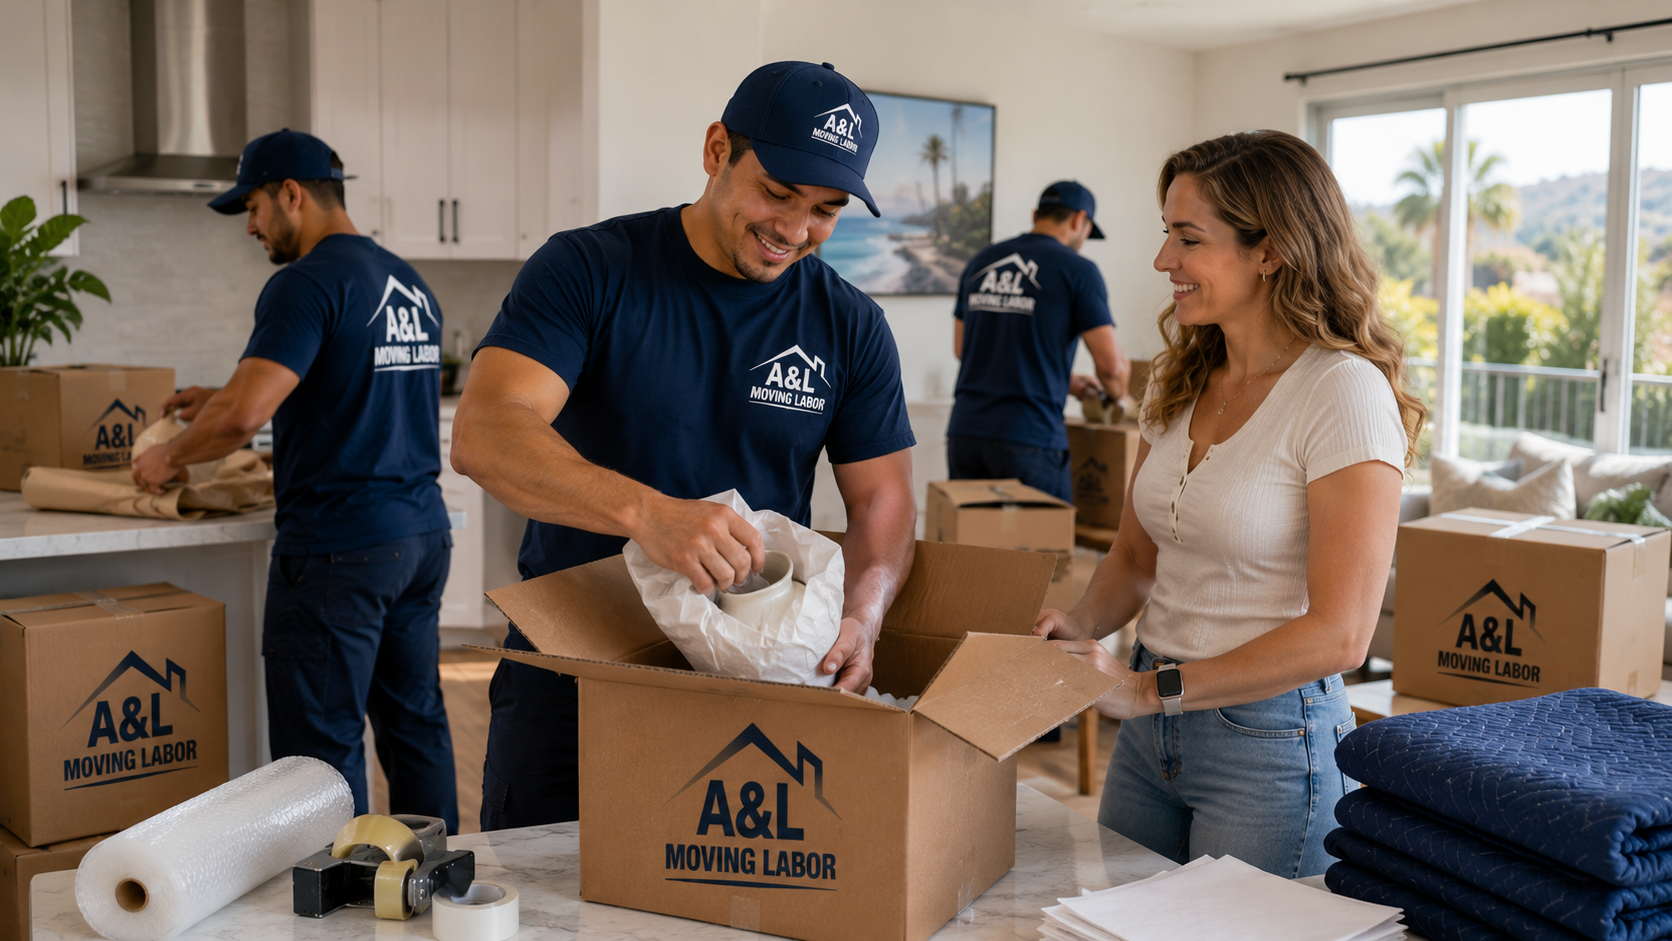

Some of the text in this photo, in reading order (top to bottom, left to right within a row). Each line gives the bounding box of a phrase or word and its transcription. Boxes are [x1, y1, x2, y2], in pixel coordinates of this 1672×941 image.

[812, 127, 839, 144] MOVING
[823, 114, 854, 140] A&L
[979, 269, 1024, 295] A&L
[386, 305, 429, 342] A&L
[374, 344, 440, 366] MOVING LABOR
[765, 362, 815, 394] A&L
[750, 385, 826, 411] MOVING LABOR
[95, 423, 134, 450] A&L
[1455, 613, 1522, 657] A&L
[1437, 650, 1541, 683] MOVING LABOR
[87, 692, 174, 749] A&L
[63, 739, 198, 781] MOVING LABOR
[696, 779, 805, 841] A&L
[665, 843, 837, 880] MOVING LABOR
